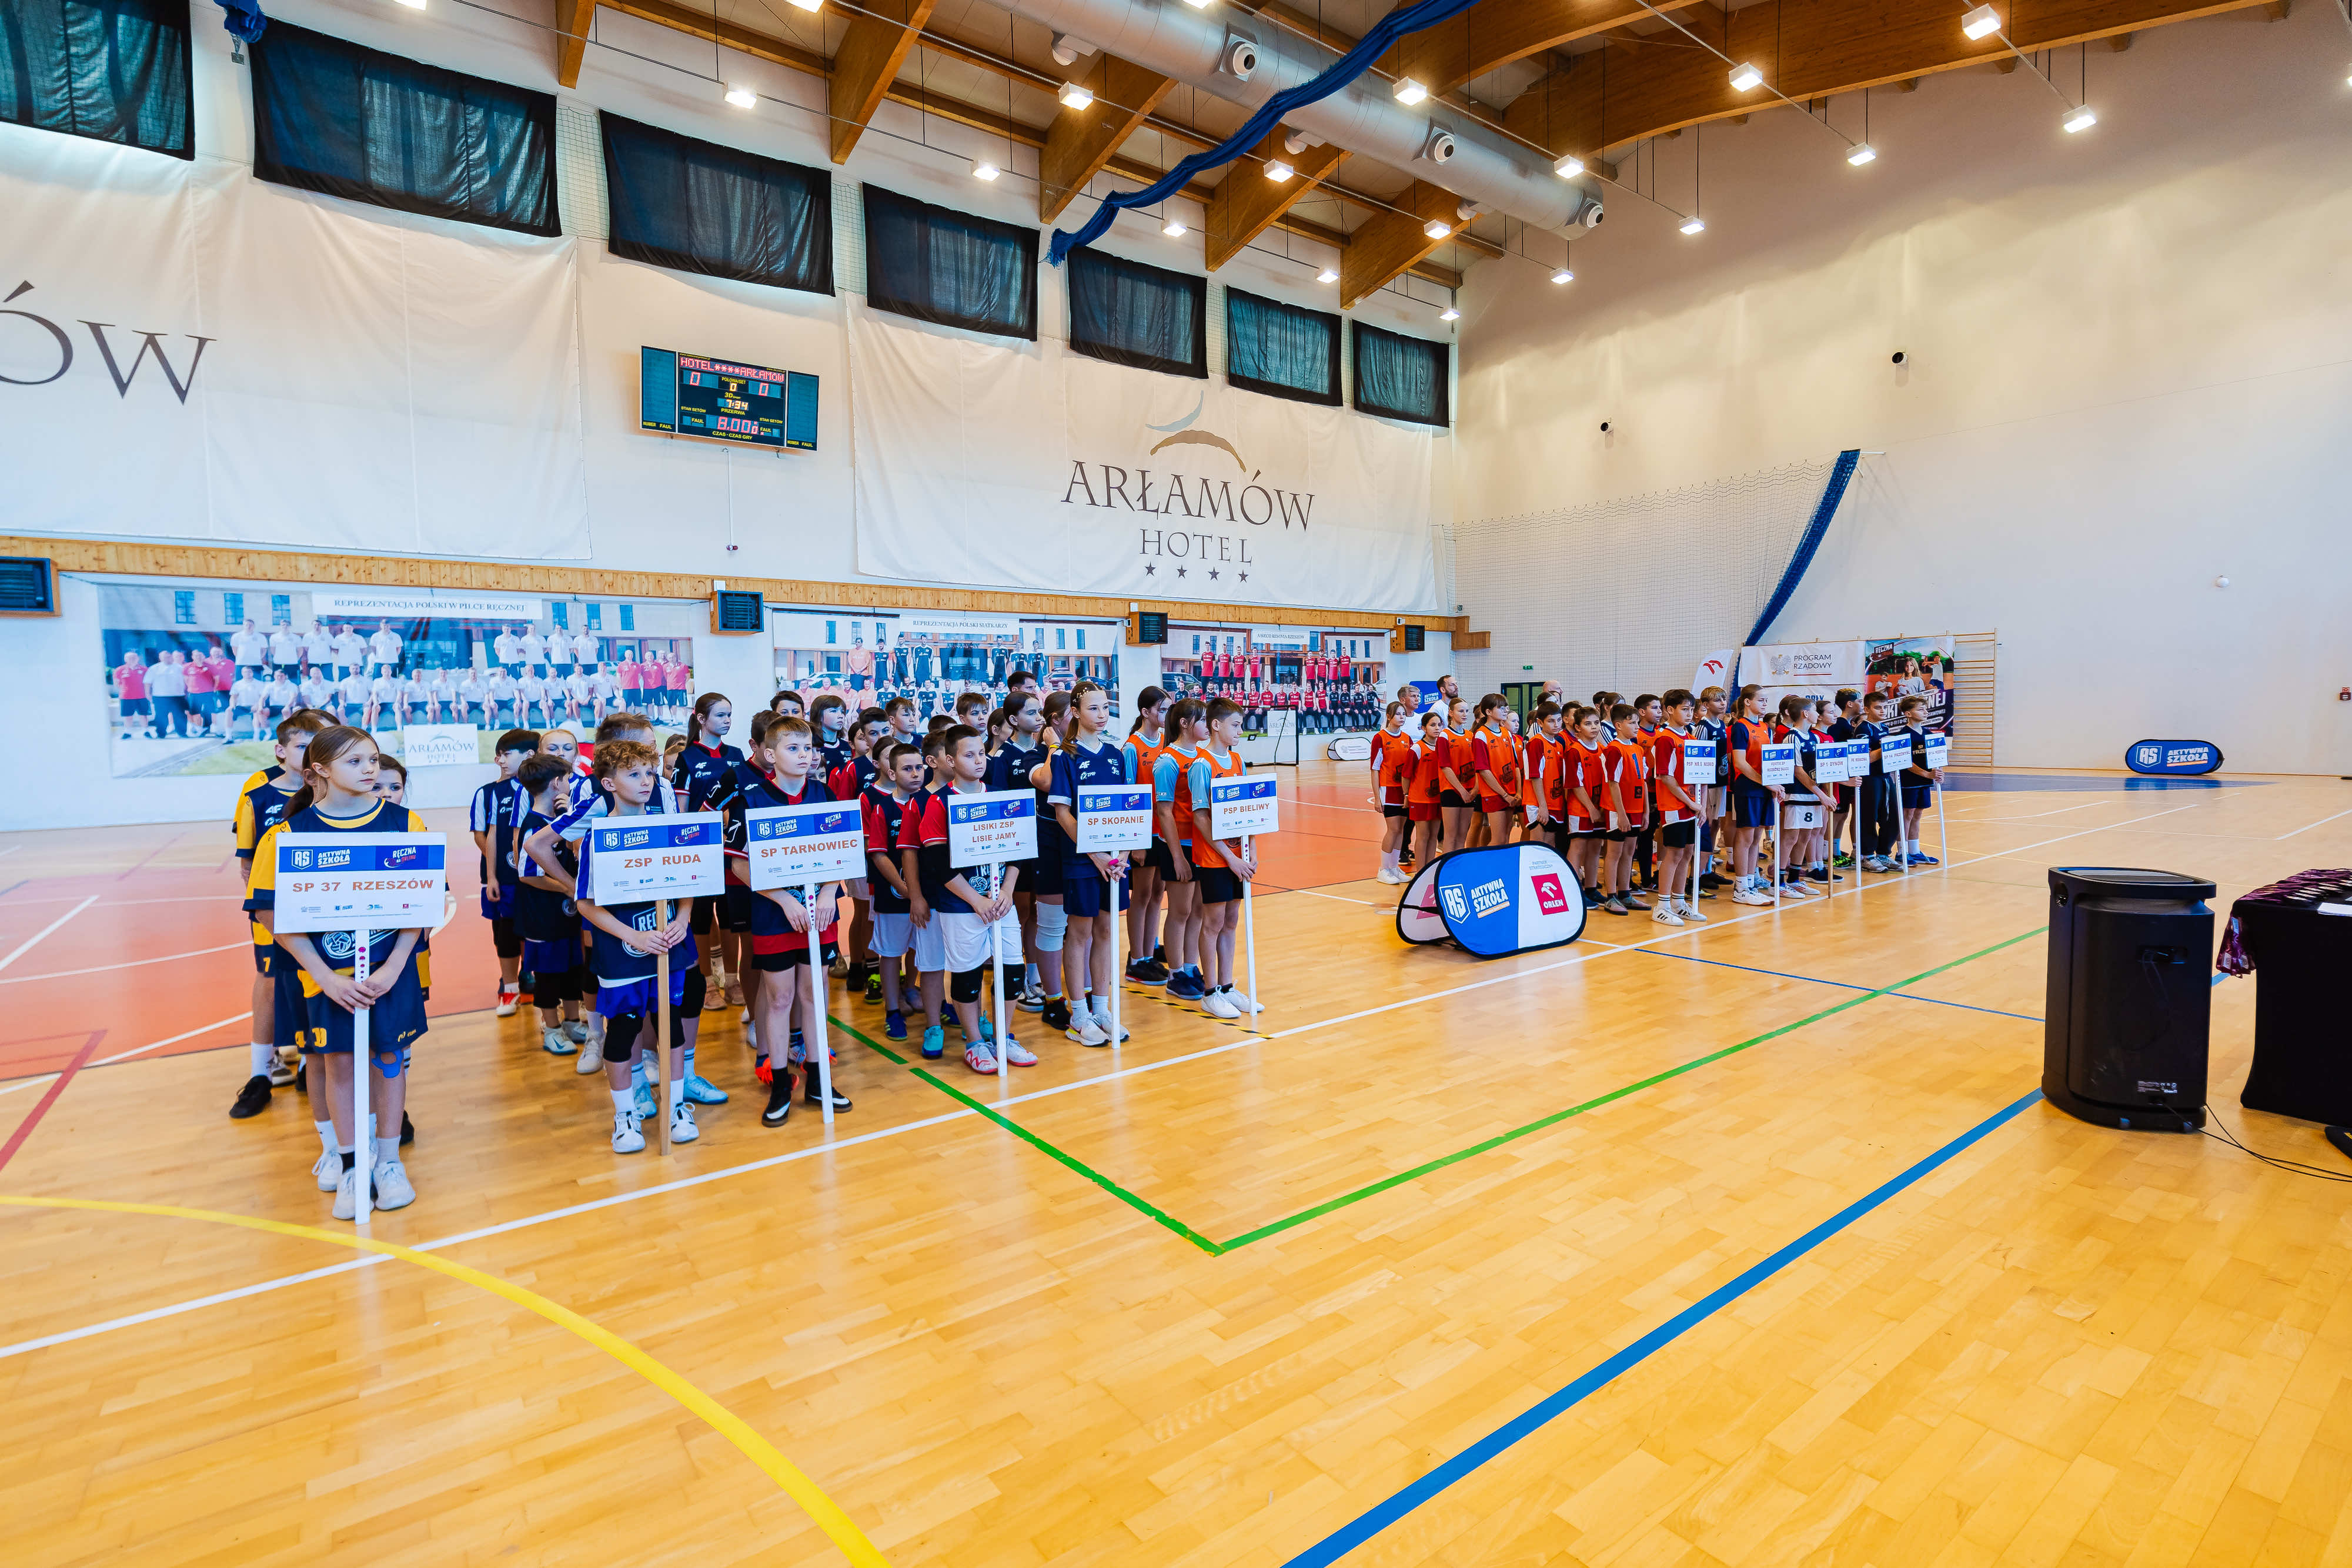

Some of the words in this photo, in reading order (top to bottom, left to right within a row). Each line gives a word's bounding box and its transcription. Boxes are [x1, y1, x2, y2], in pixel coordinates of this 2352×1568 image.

[680, 357, 714, 372] HOTEL
[690, 372, 701, 386] 0
[730, 382, 737, 392] 0
[759, 382, 769, 396] 0
[1060, 460, 1315, 532] ARŁAMÓW
[1140, 529, 1253, 567] HOTEL
[334, 600, 413, 609] REPREZENTACJA
[416, 601, 447, 609] POLSKI
[2168, 747, 2209, 755] AKTYWNA
[2167, 753, 2209, 763] SZKOŁA
[970, 808, 987, 817] SZKOŁA
[1240, 803, 1269, 813] BIELIWY
[826, 813, 841, 824] RĘCZNA
[1102, 816, 1144, 825] SKOPANIE
[1804, 812, 1813, 822] 8
[775, 818, 797, 828] AKTYWNA
[775, 823, 797, 834] SZKOŁA
[973, 823, 997, 831] LISIKI
[624, 830, 649, 838] AKTYWNA
[681, 825, 700, 836] RĘCZNA
[995, 832, 1017, 840] JAMY
[624, 834, 649, 845] SZKOŁA
[318, 849, 350, 858] AKTYWNA
[393, 847, 416, 858] RĘCZNA
[761, 848, 777, 858] SP
[781, 839, 857, 855] TARNOWIEC
[318, 854, 350, 865] SZKOŁA
[624, 857, 652, 868] ZSP
[662, 854, 701, 865] RUDA
[292, 883, 315, 892] SP
[321, 882, 341, 891] 37
[353, 878, 434, 891] RZESZÓW
[1471, 878, 1504, 900] AKTYWNA
[1444, 888, 1466, 918] AS
[1474, 888, 1508, 912] SZKOŁA
[1543, 899, 1564, 909] ORLEN
